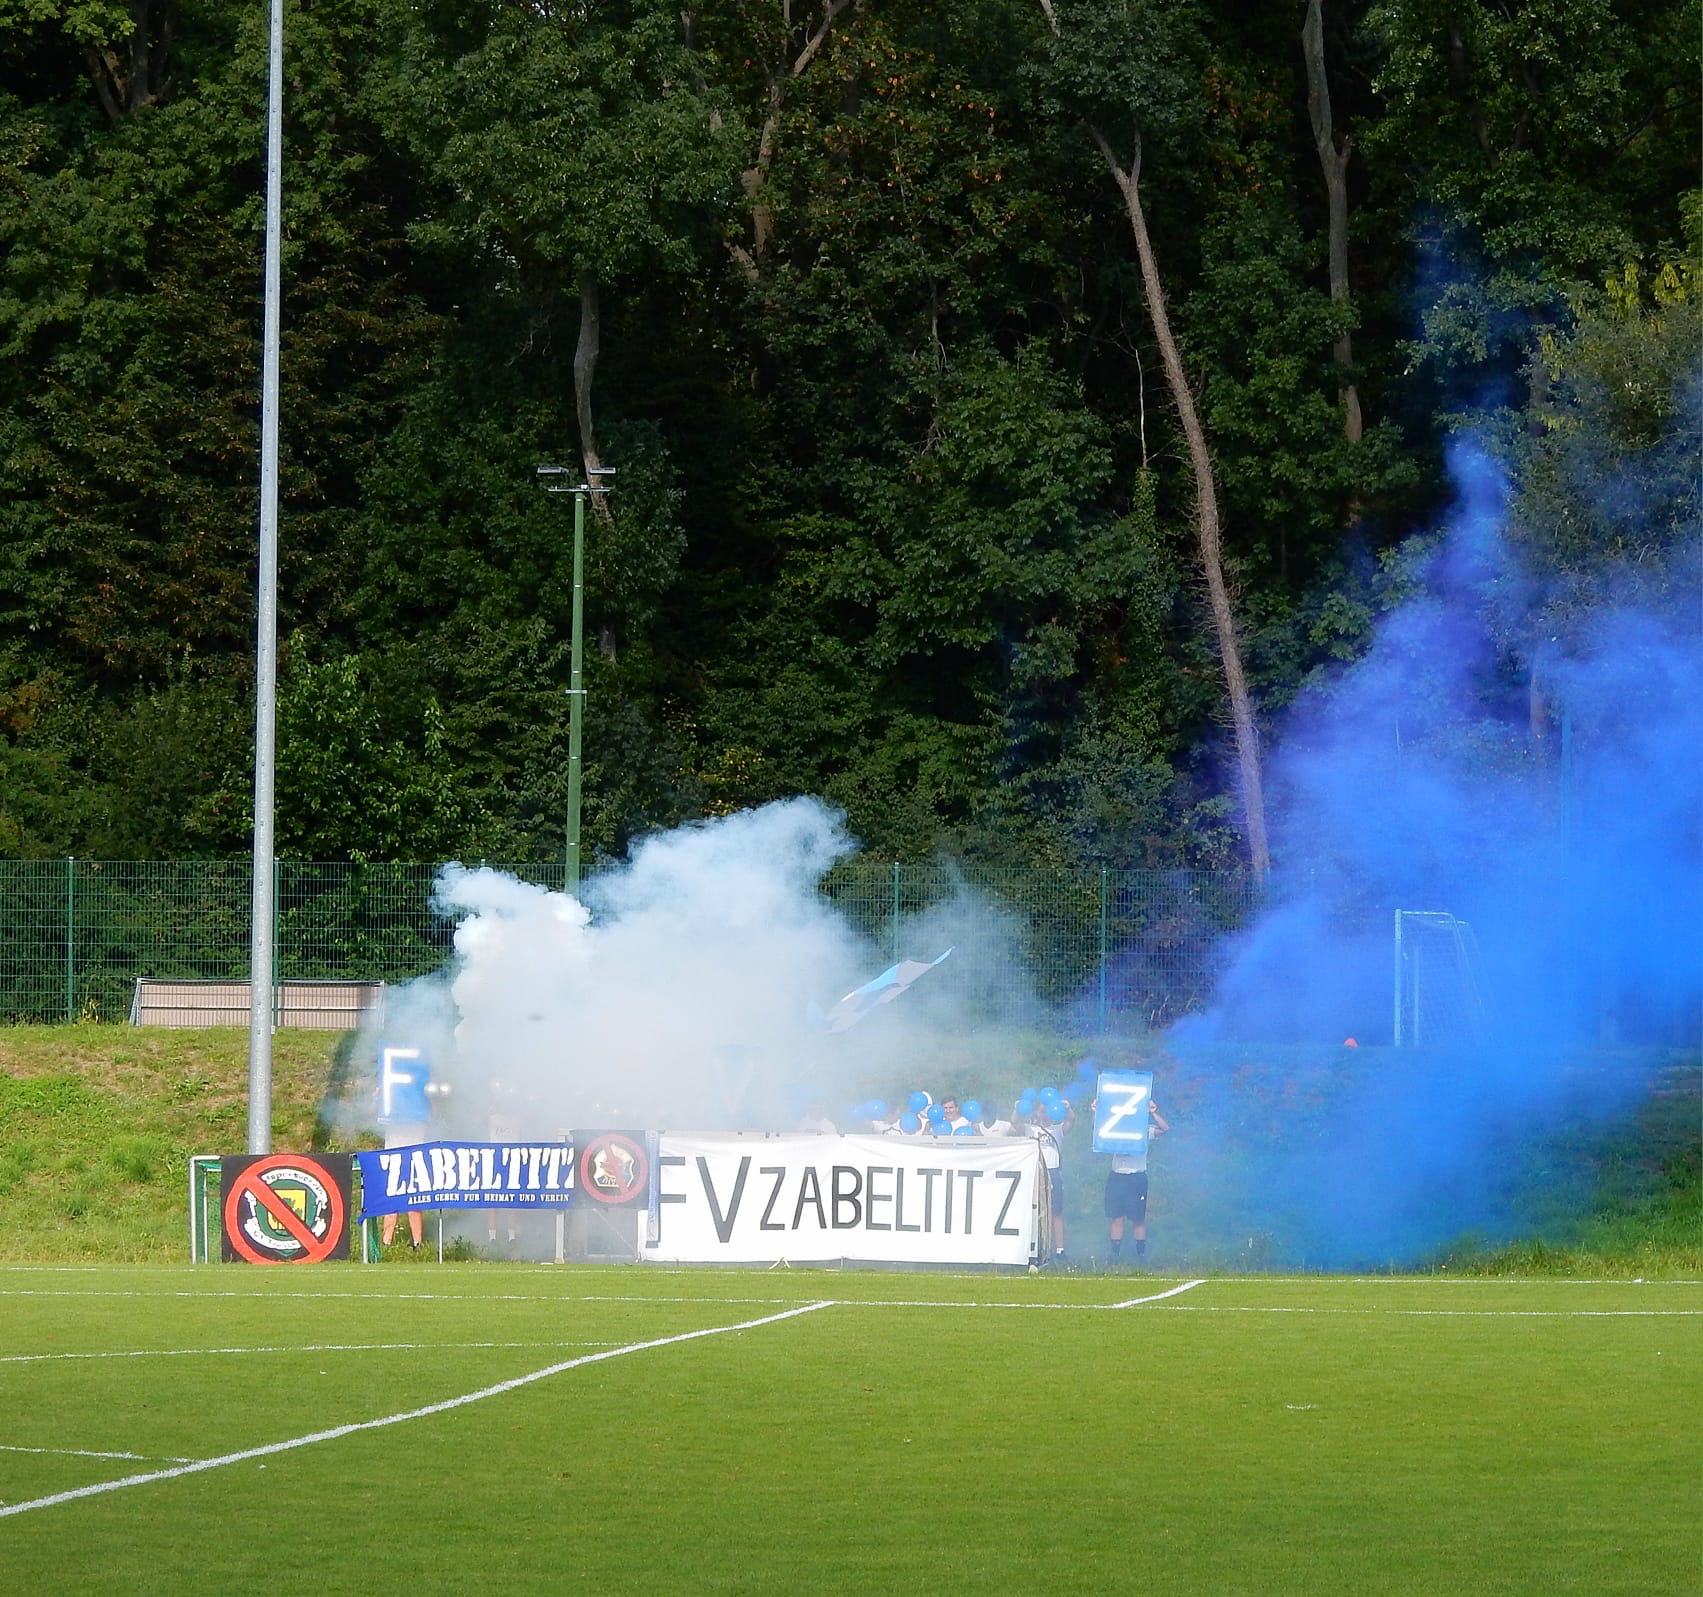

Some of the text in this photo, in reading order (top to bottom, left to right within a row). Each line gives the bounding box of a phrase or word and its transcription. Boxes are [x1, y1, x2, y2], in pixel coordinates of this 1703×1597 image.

[383, 1048, 420, 1117] F
[1099, 1084, 1147, 1140] Z
[407, 1194, 432, 1205] ALLES
[434, 1193, 460, 1203] GEBEN
[484, 1193, 515, 1202] HEIMAT
[519, 1193, 536, 1202] UND
[540, 1193, 569, 1202] VEREIN
[759, 1165, 1020, 1237] ZABELTITZ
